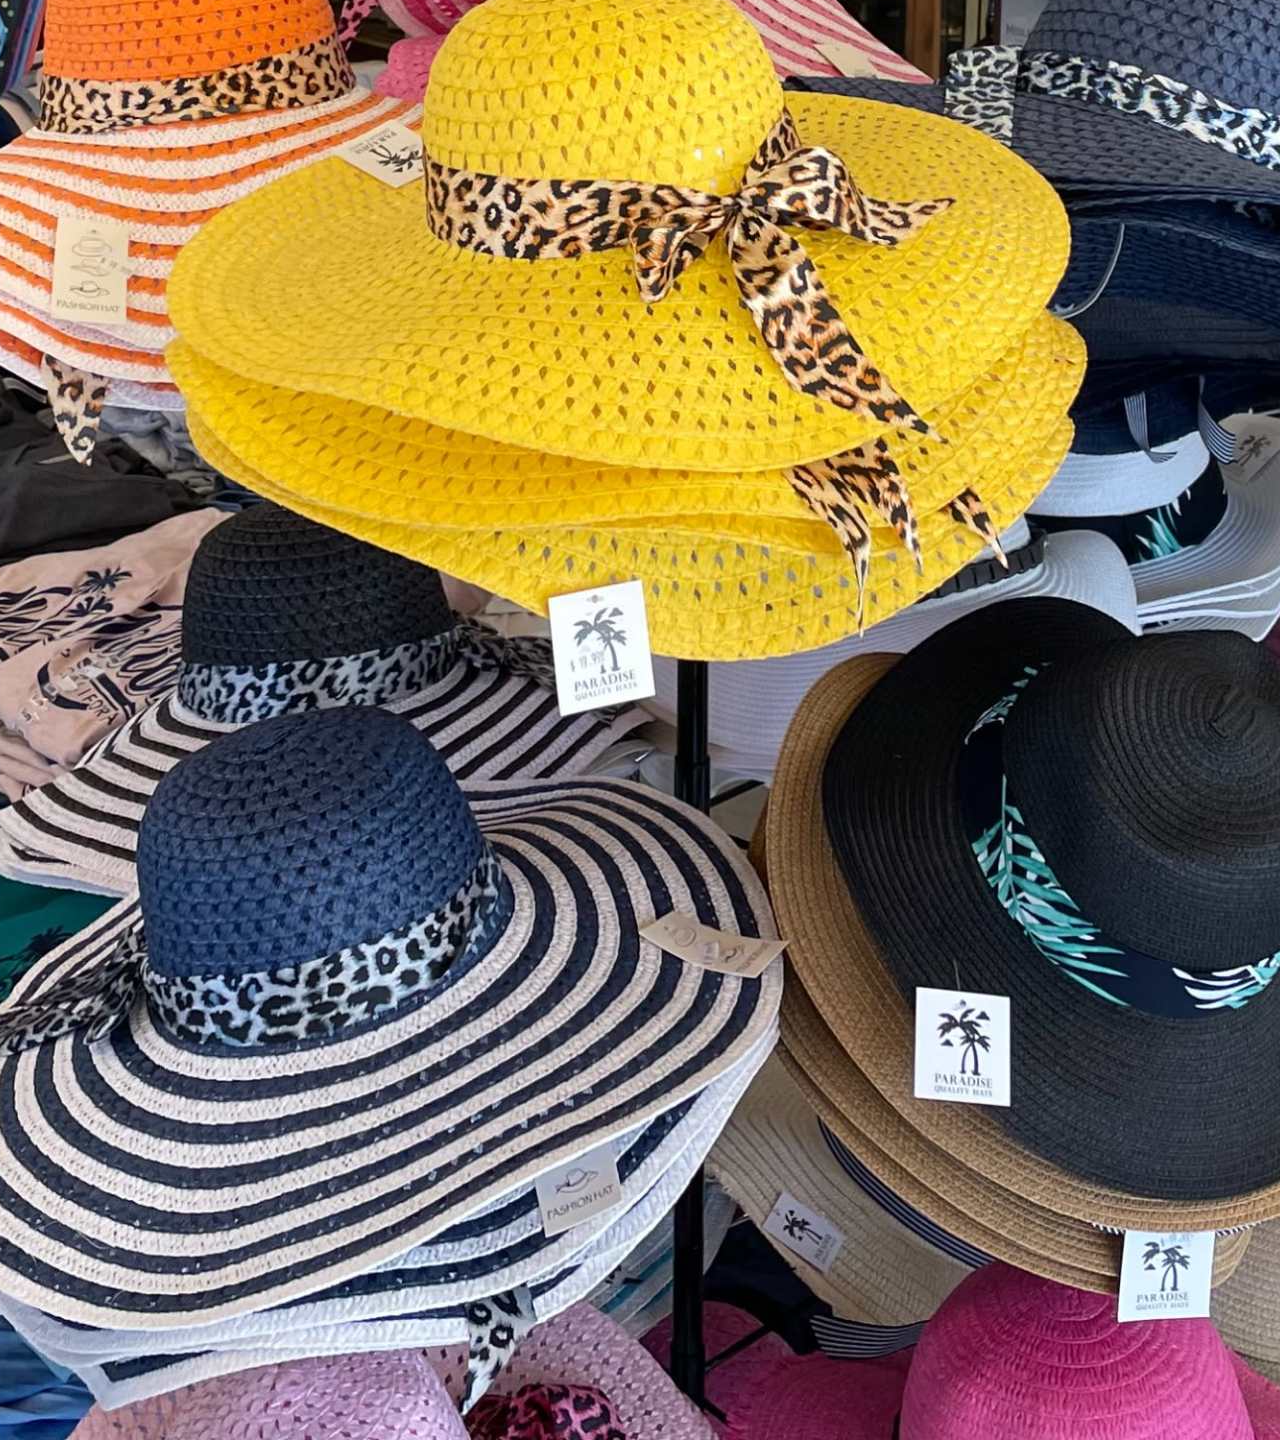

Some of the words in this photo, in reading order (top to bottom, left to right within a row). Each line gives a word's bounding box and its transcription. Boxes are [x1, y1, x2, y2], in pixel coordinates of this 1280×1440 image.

[574, 669, 636, 693] PARADISE
[934, 1072, 993, 1089] PARADISE
[546, 1193, 593, 1221] FASHION
[1136, 1292, 1189, 1304] PARADISE
